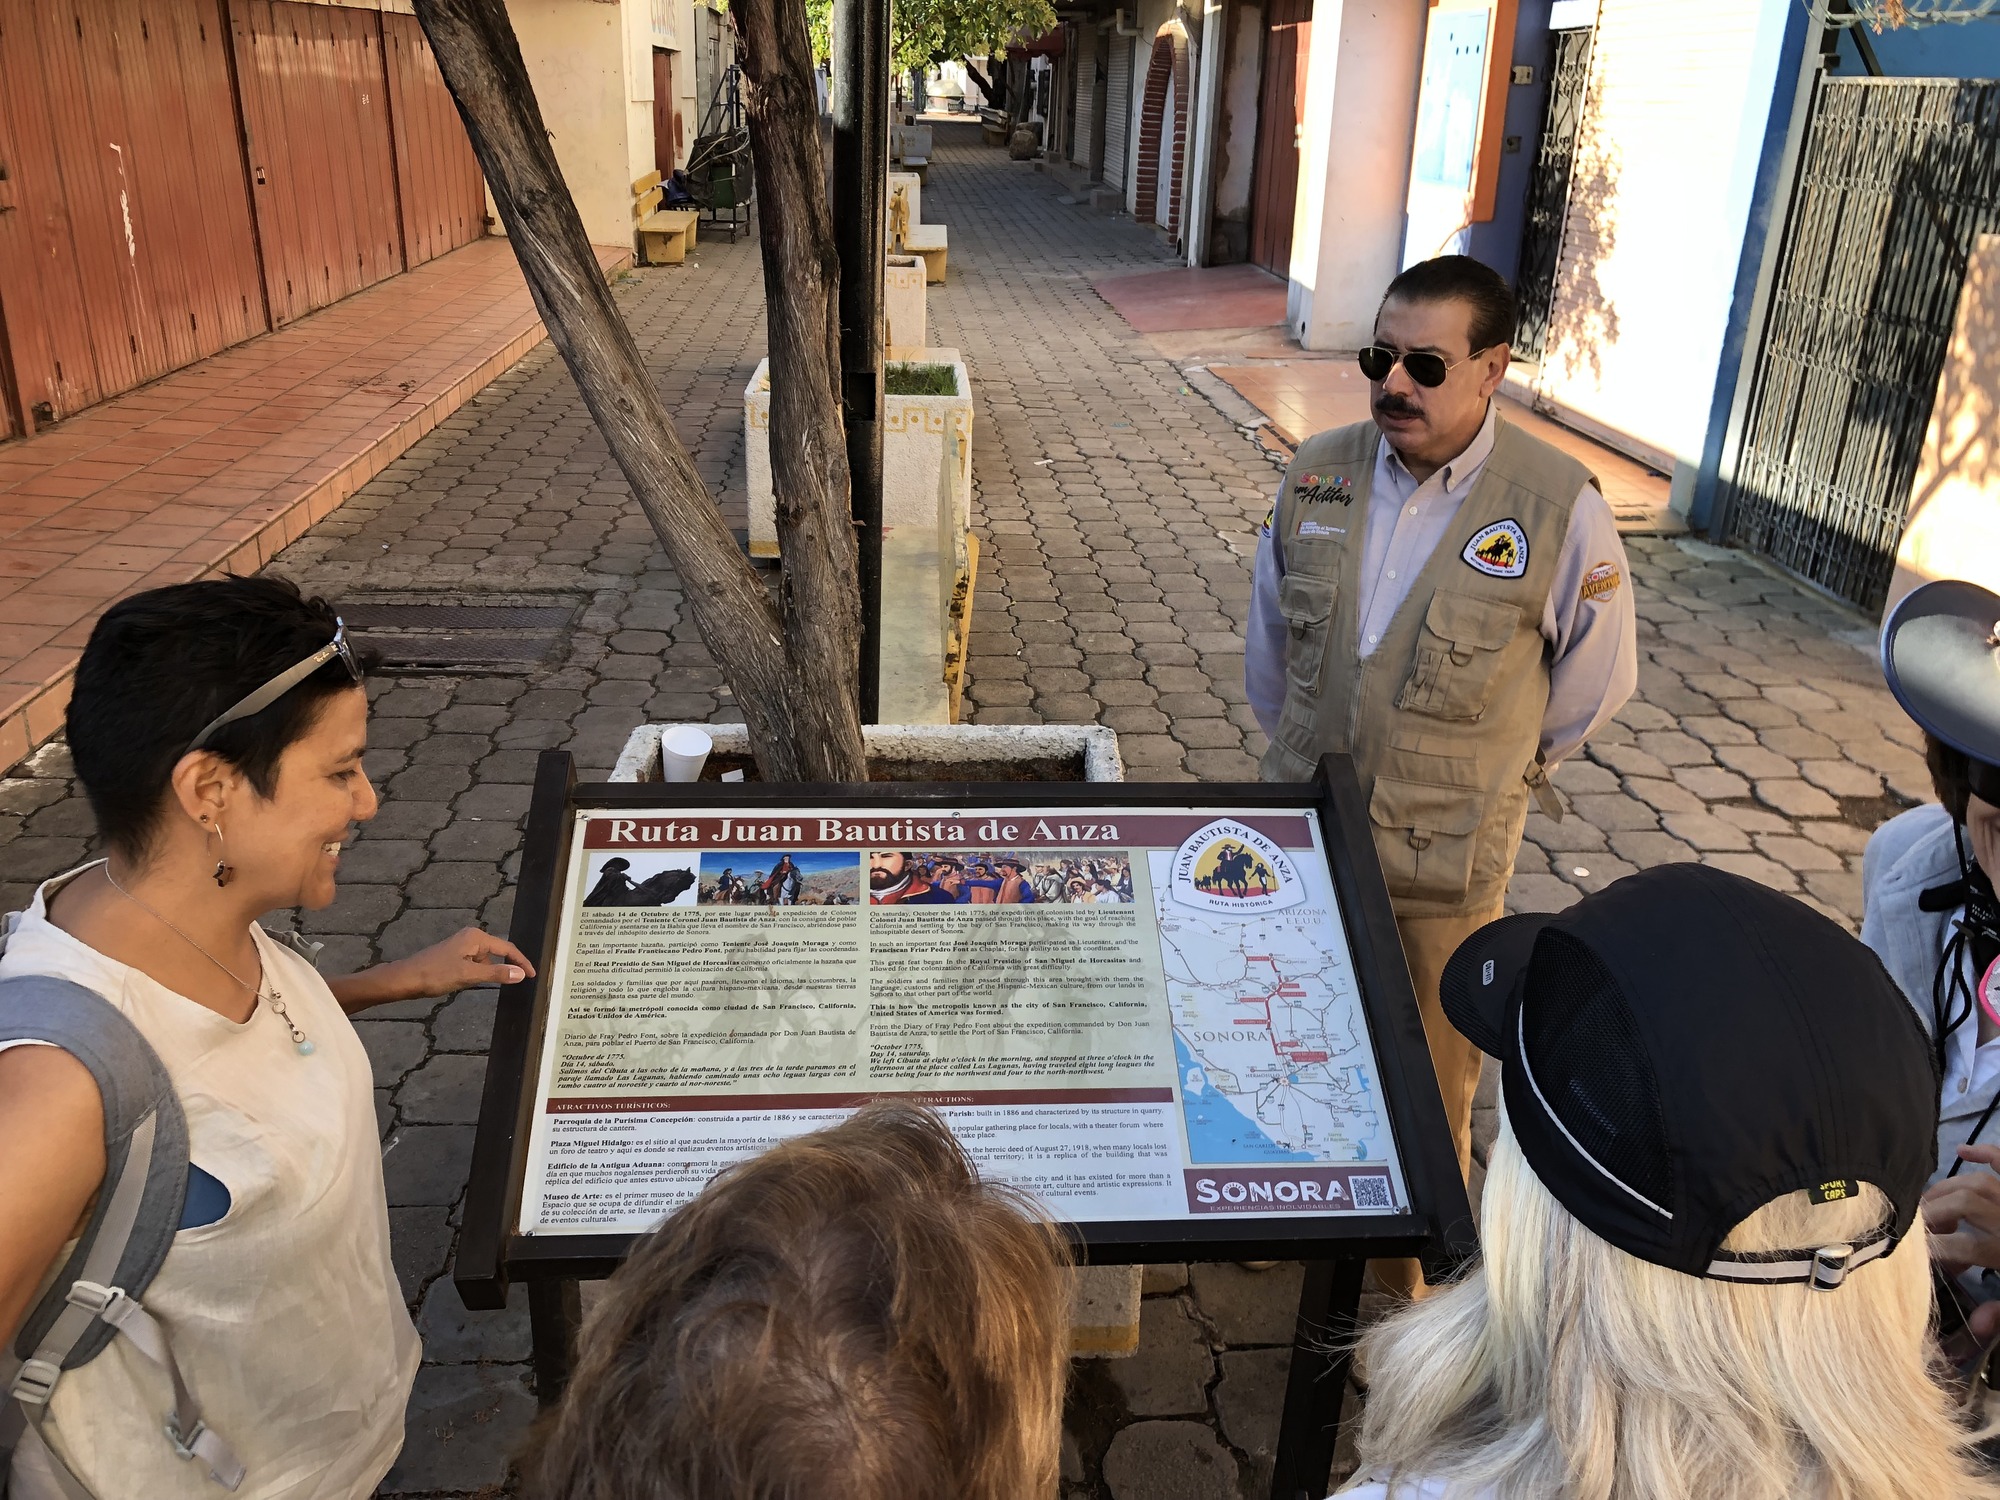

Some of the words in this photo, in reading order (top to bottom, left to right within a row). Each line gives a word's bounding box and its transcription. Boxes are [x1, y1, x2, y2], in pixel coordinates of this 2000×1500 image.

[1471, 534, 1484, 550] JUAN
[1485, 525, 1517, 536] BAUTISTA
[1516, 535, 1523, 544] DE
[607, 820, 699, 842] Ruta
[712, 819, 802, 842] Juan
[817, 818, 966, 841] Bautista
[978, 818, 1018, 840] de
[1028, 818, 1120, 840] Anza
[1178, 853, 1193, 883] JUAN
[1190, 826, 1248, 853] BAUTISTA
[1252, 837, 1271, 852] DE
[1269, 854, 1293, 883] ANZA
[1209, 899, 1229, 907] RUTA
[1232, 898, 1274, 908] HISTÓRICA
[628, 1004, 663, 1013] metrópoli
[931, 1002, 969, 1010] metropolis
[1194, 1031, 1267, 1042] SONORA
[553, 1118, 591, 1126] Parroquia
[649, 1115, 695, 1124] Concepción:
[741, 1115, 761, 1123] partir
[957, 1124, 983, 1132] popular
[984, 1124, 1017, 1132] gathering
[1018, 1123, 1036, 1131] place
[1034, 1145, 1058, 1153] August
[544, 1177, 570, 1186] réplica
[1196, 1179, 1349, 1203] SONORA
[1824, 1189, 1846, 1200] CAPS
